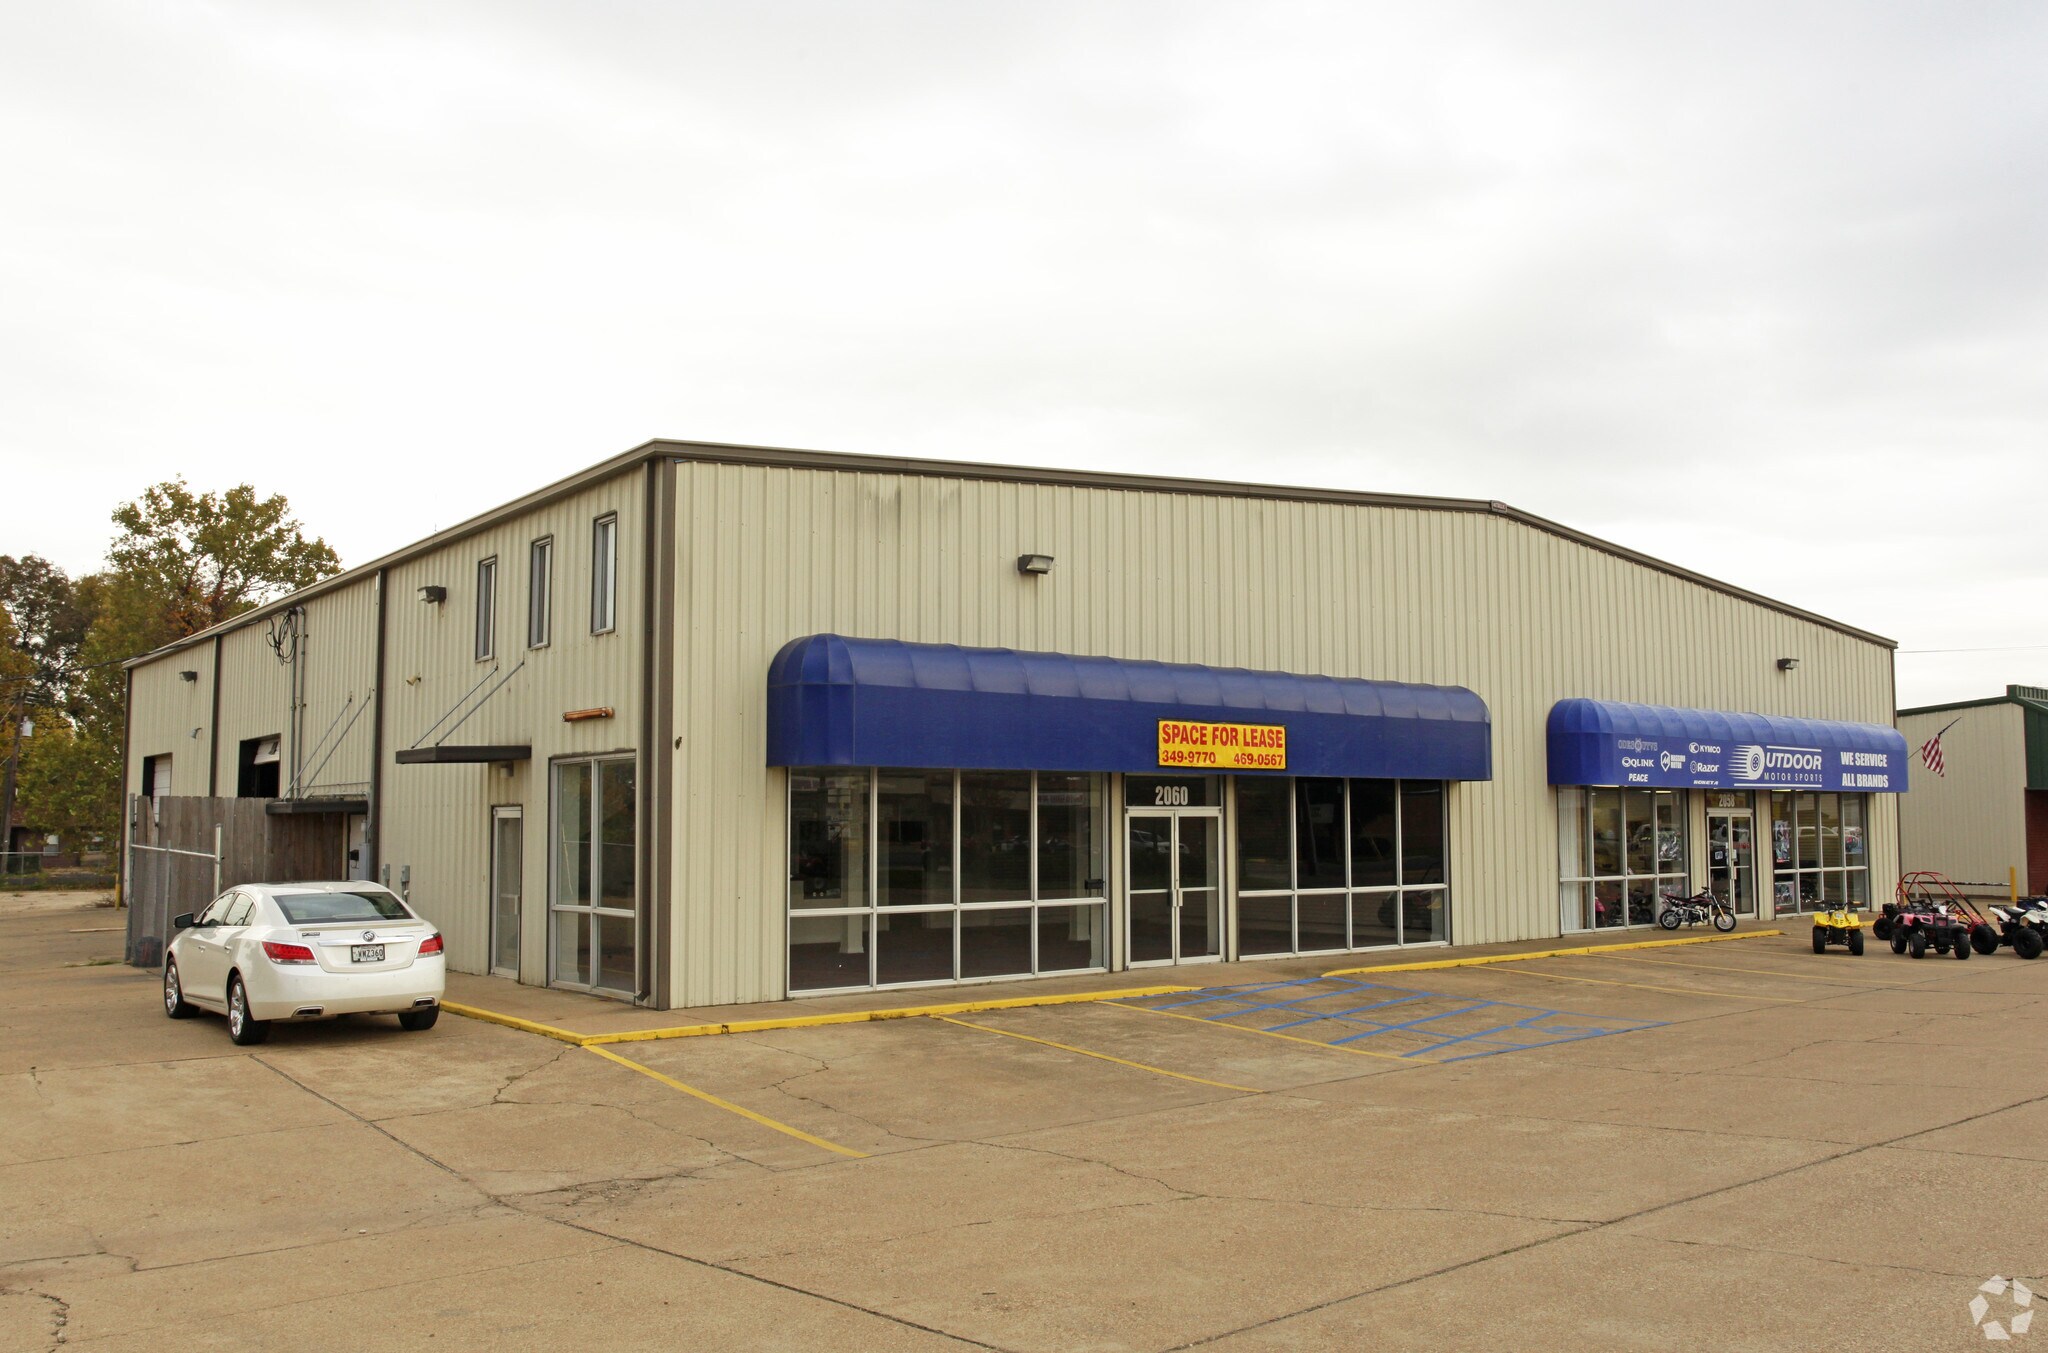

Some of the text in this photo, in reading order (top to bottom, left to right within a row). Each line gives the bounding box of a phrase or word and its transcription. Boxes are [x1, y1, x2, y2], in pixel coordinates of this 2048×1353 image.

[1162, 724, 1283, 748] SPACE FOR LEASE
[1700, 744, 1721, 754] KYMCO
[1630, 759, 1654, 768] QLINK
[1840, 752, 1888, 767] WE SERVICE
[1697, 763, 1719, 772] Razor
[1628, 773, 1648, 782] PEACE
[1764, 772, 1823, 782] MOTOR SPORTS
[1842, 773, 1889, 788] ALL BRANDS
[1155, 785, 1188, 806] 2060
[1719, 793, 1735, 807] 2058
